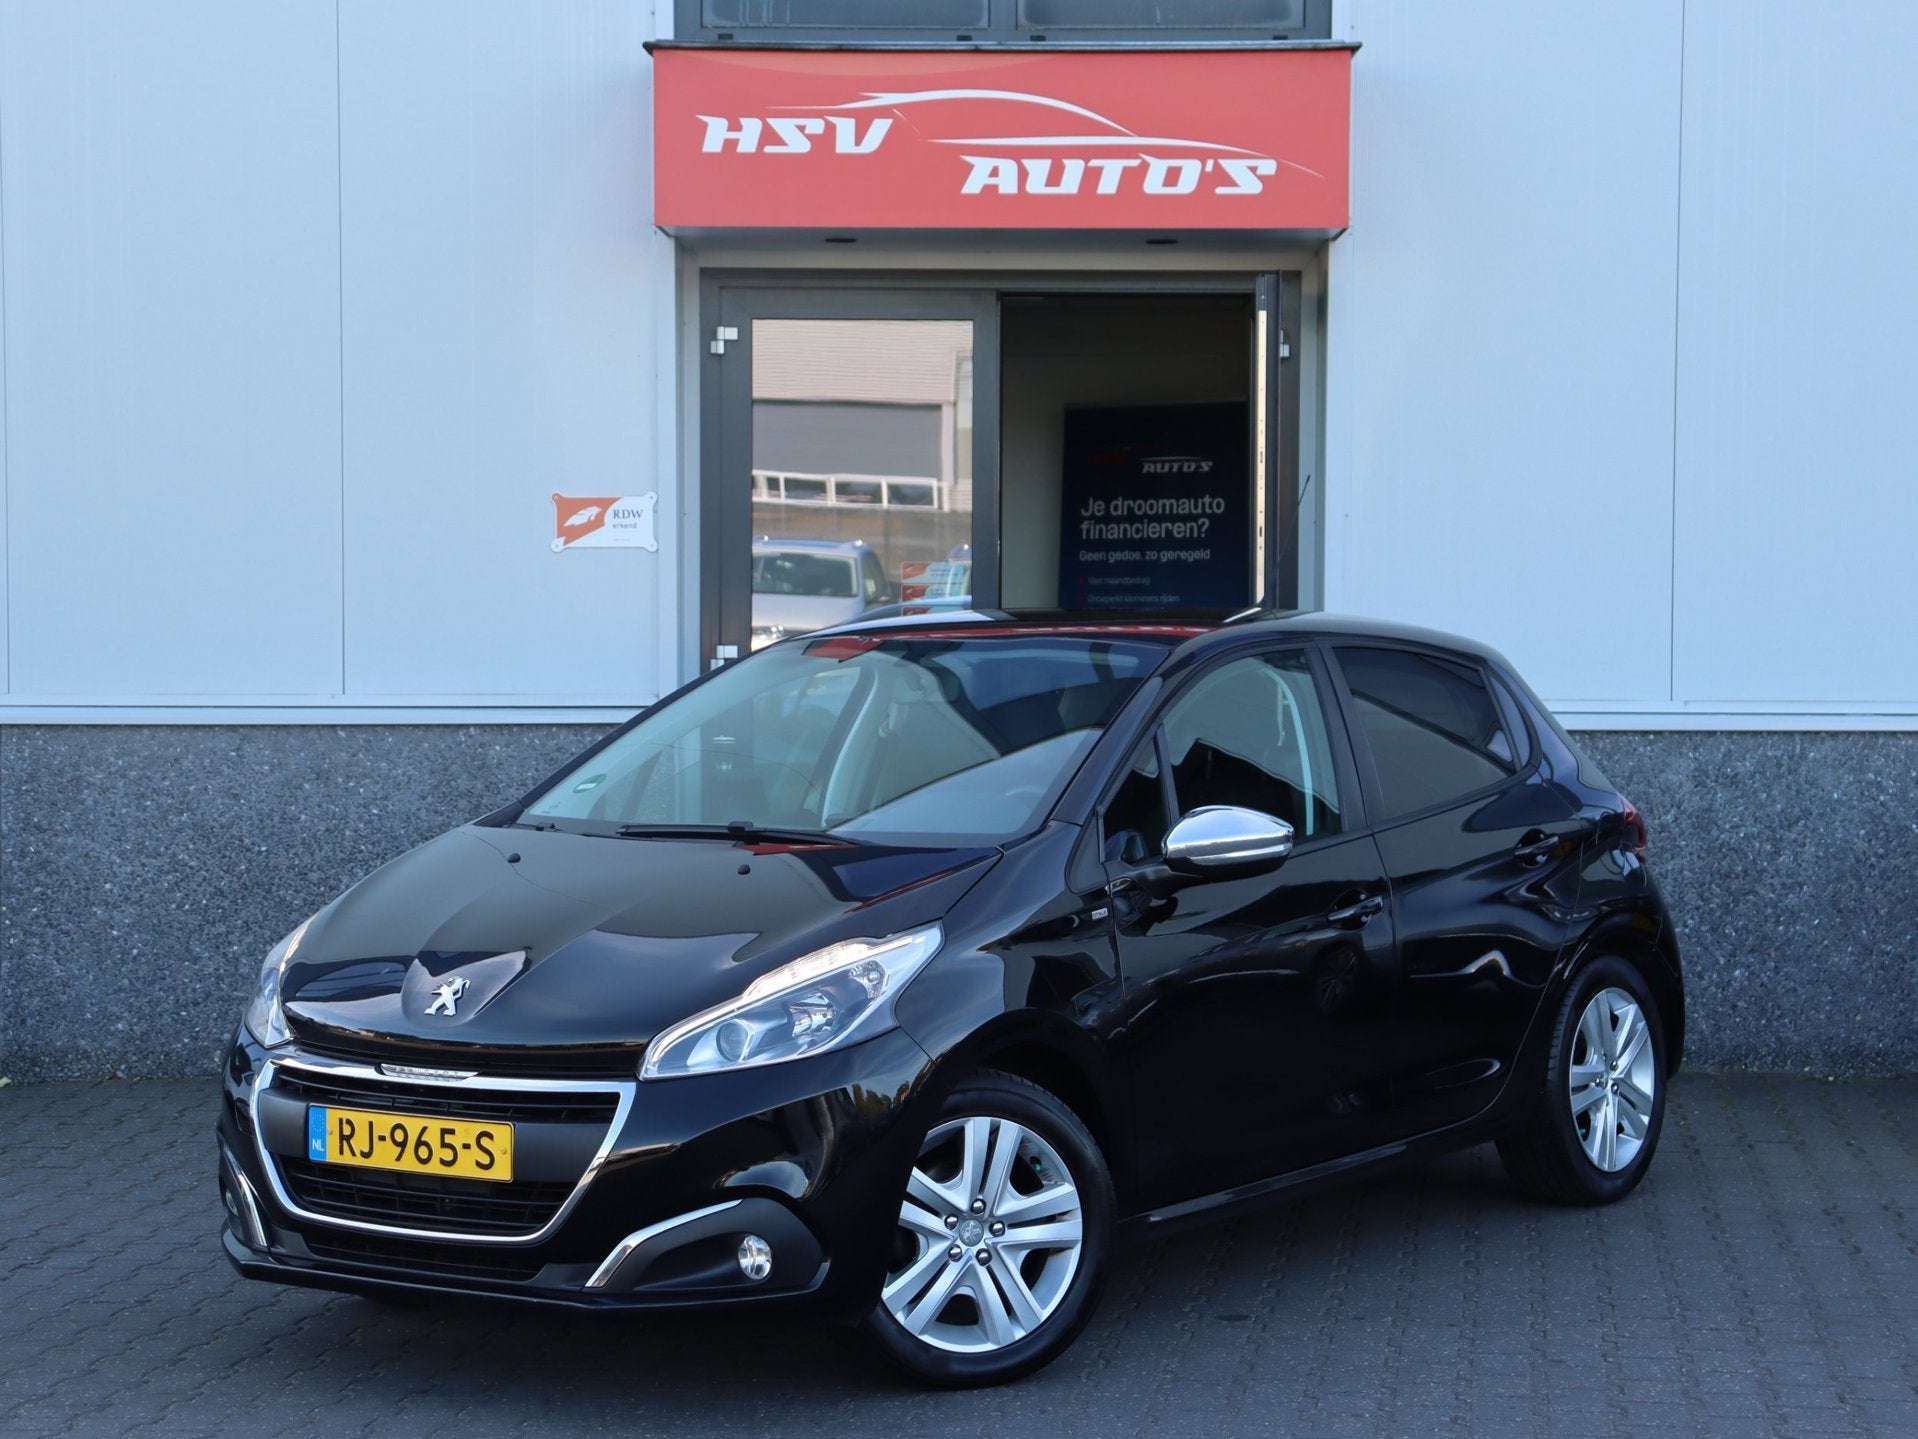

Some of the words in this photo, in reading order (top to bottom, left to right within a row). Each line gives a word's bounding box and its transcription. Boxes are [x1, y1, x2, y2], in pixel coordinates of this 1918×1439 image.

[696, 115, 893, 153] HSV
[960, 152, 1277, 195] AUTO'S
[1142, 461, 1213, 473] AUTO'S
[612, 508, 643, 519] RDW
[1080, 497, 1106, 516] Je
[1110, 494, 1225, 516] droomauto
[1080, 518, 1210, 539] financieren?
[1079, 551, 1106, 561] Geen
[1145, 551, 1158, 560] zo
[1160, 549, 1211, 562] geregeld
[312, 1138, 325, 1151] NL
[338, 1117, 495, 1170] RJ-965-S
